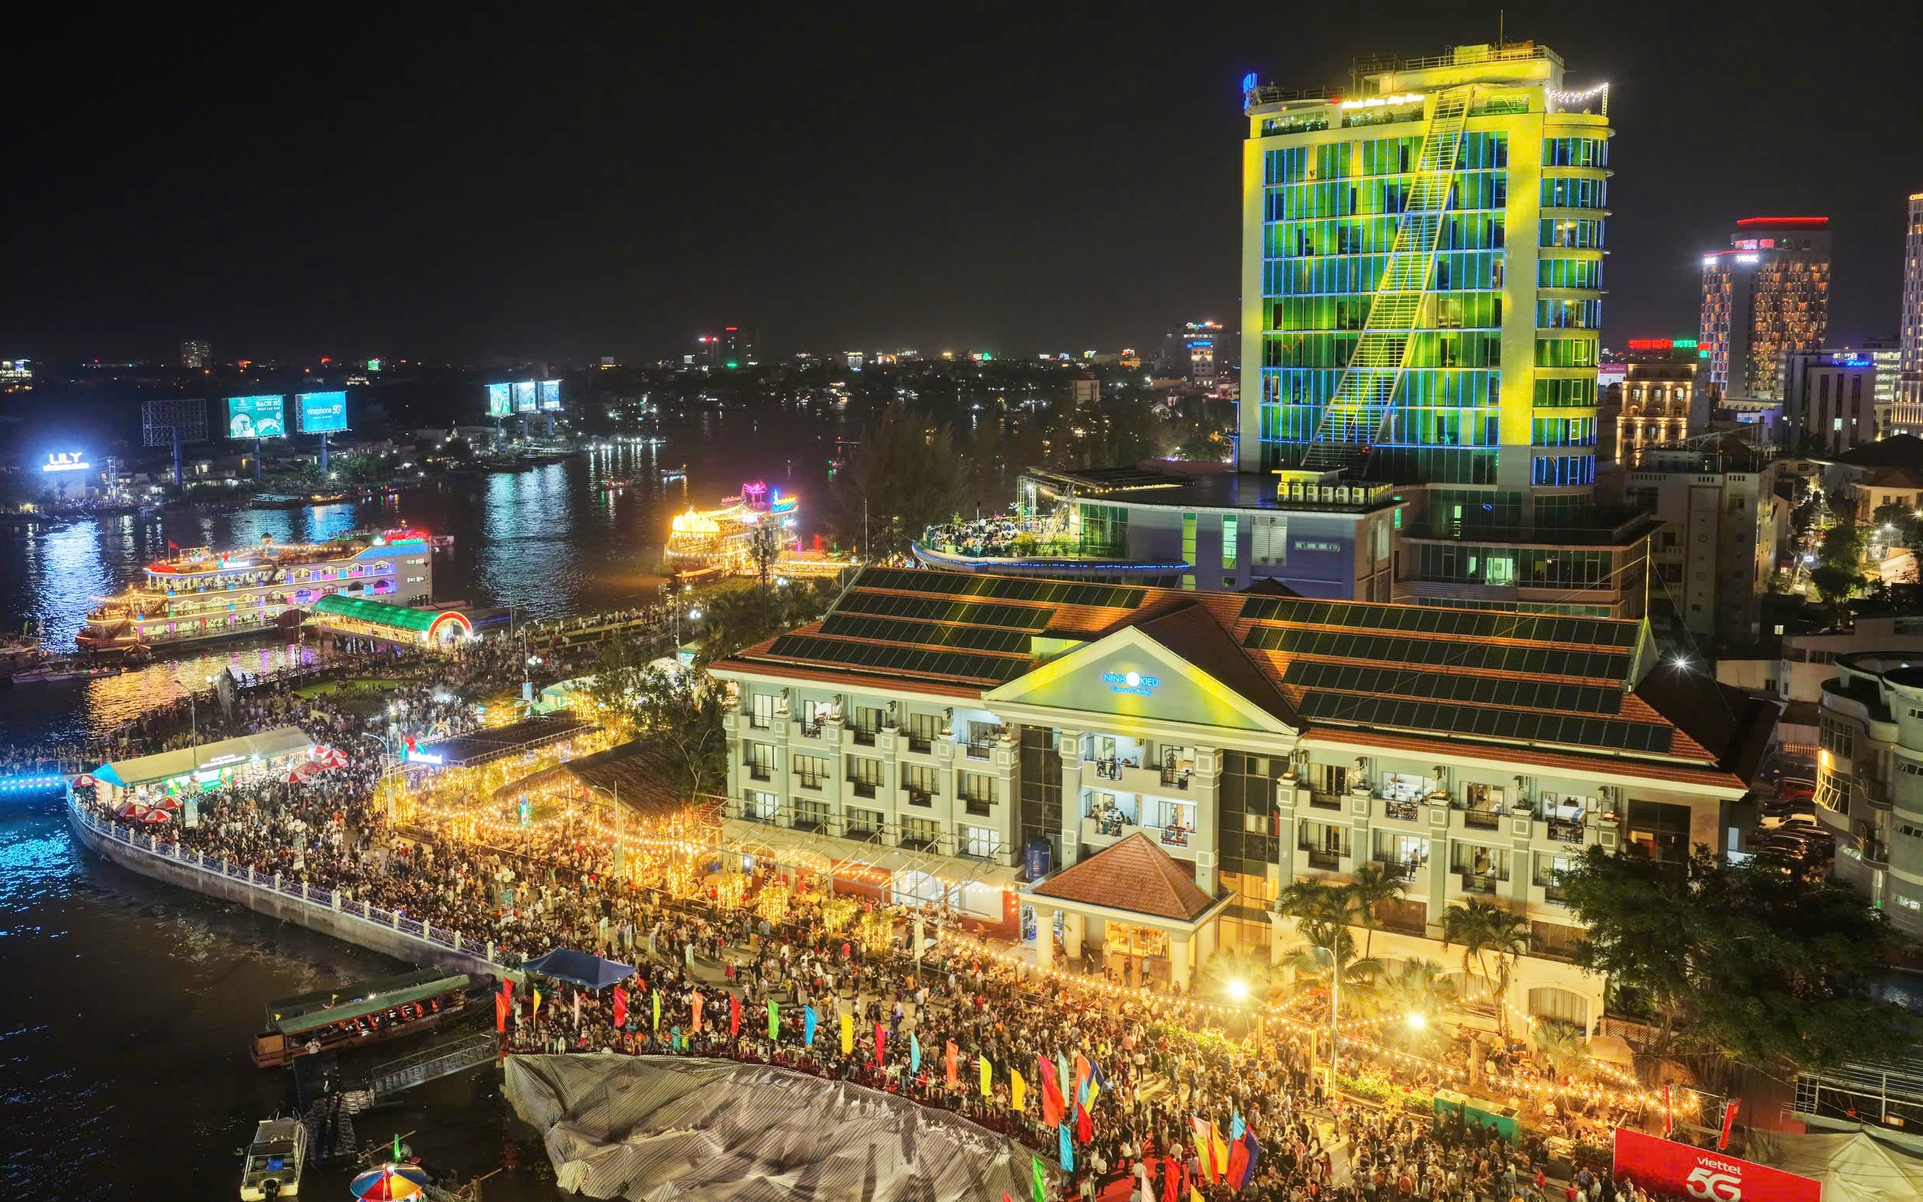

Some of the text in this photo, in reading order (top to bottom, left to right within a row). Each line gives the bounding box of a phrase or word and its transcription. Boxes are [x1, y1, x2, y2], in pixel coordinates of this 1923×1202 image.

[1673, 340, 1698, 348] HOTEL
[50, 452, 82, 464] LILY
[1103, 672, 1159, 687] NINH KIEU
[1697, 1157, 1742, 1175] viettel
[1686, 1167, 1742, 1202] 5G
